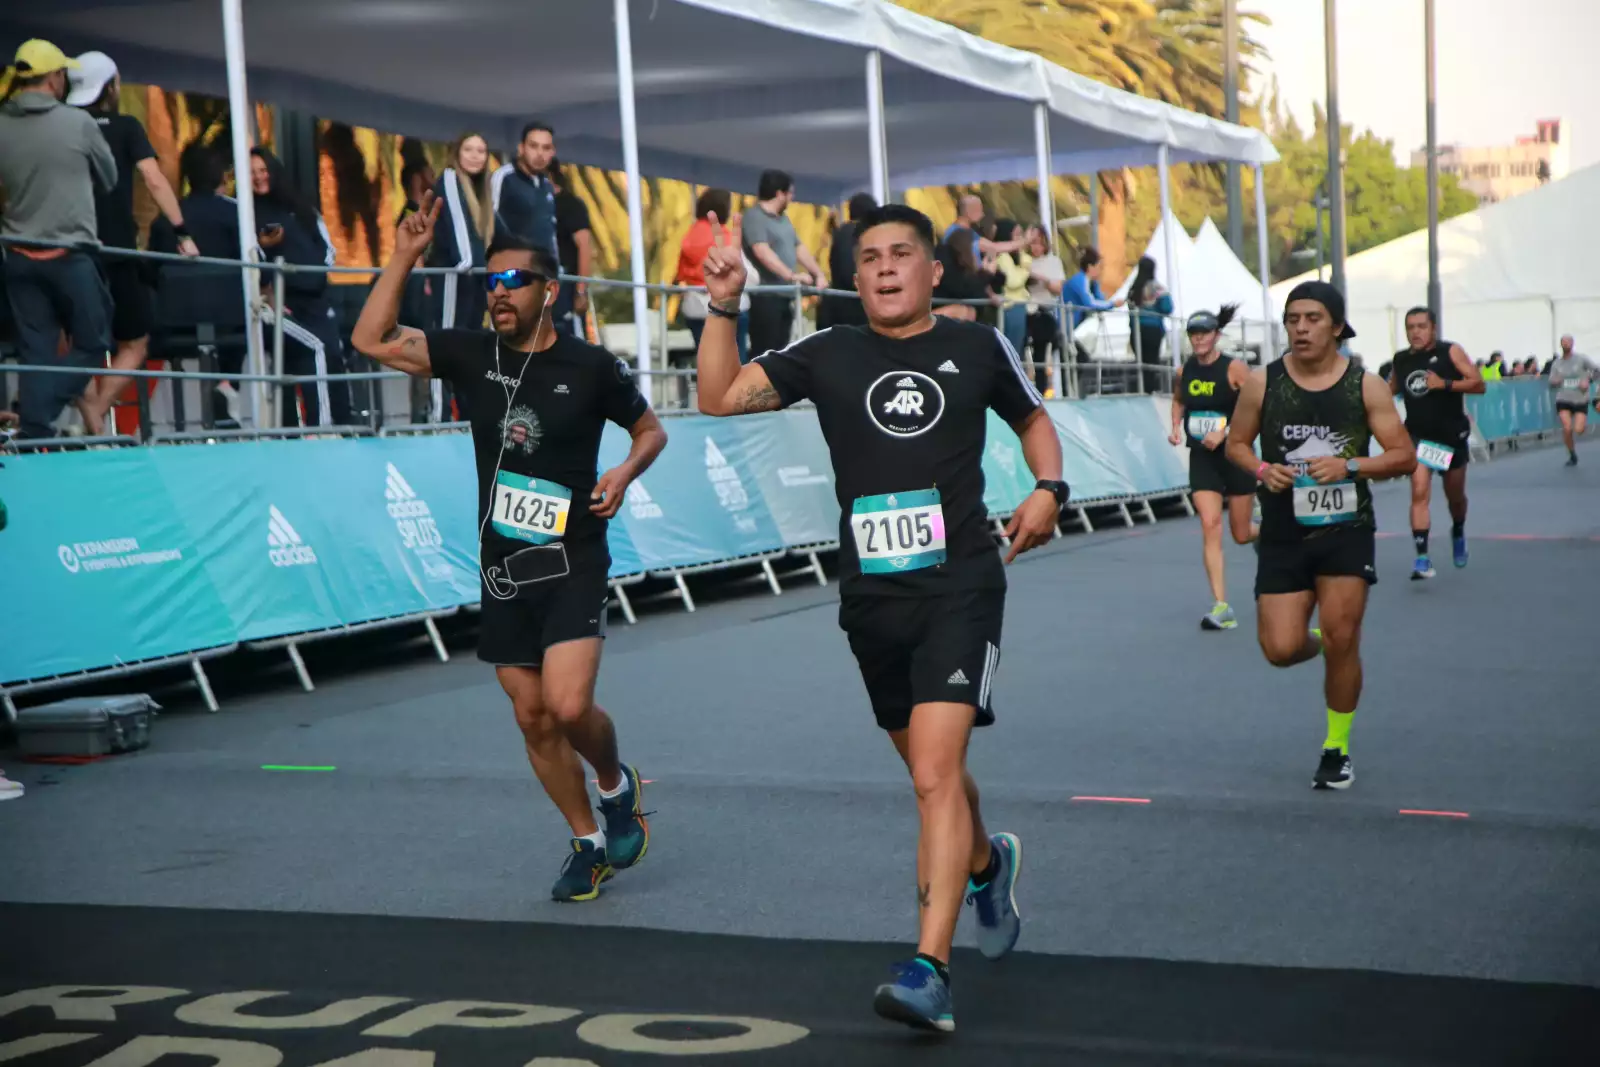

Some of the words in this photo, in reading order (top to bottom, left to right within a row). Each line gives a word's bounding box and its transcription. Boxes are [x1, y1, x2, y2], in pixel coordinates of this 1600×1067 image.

[484, 370, 521, 388] SERGIO
[883, 390, 925, 416] AR
[504, 492, 559, 530] 1625
[1307, 488, 1344, 512] 940
[861, 512, 933, 553] 2105
[269, 545, 317, 567] adidas
[947, 677, 970, 685] adidas
